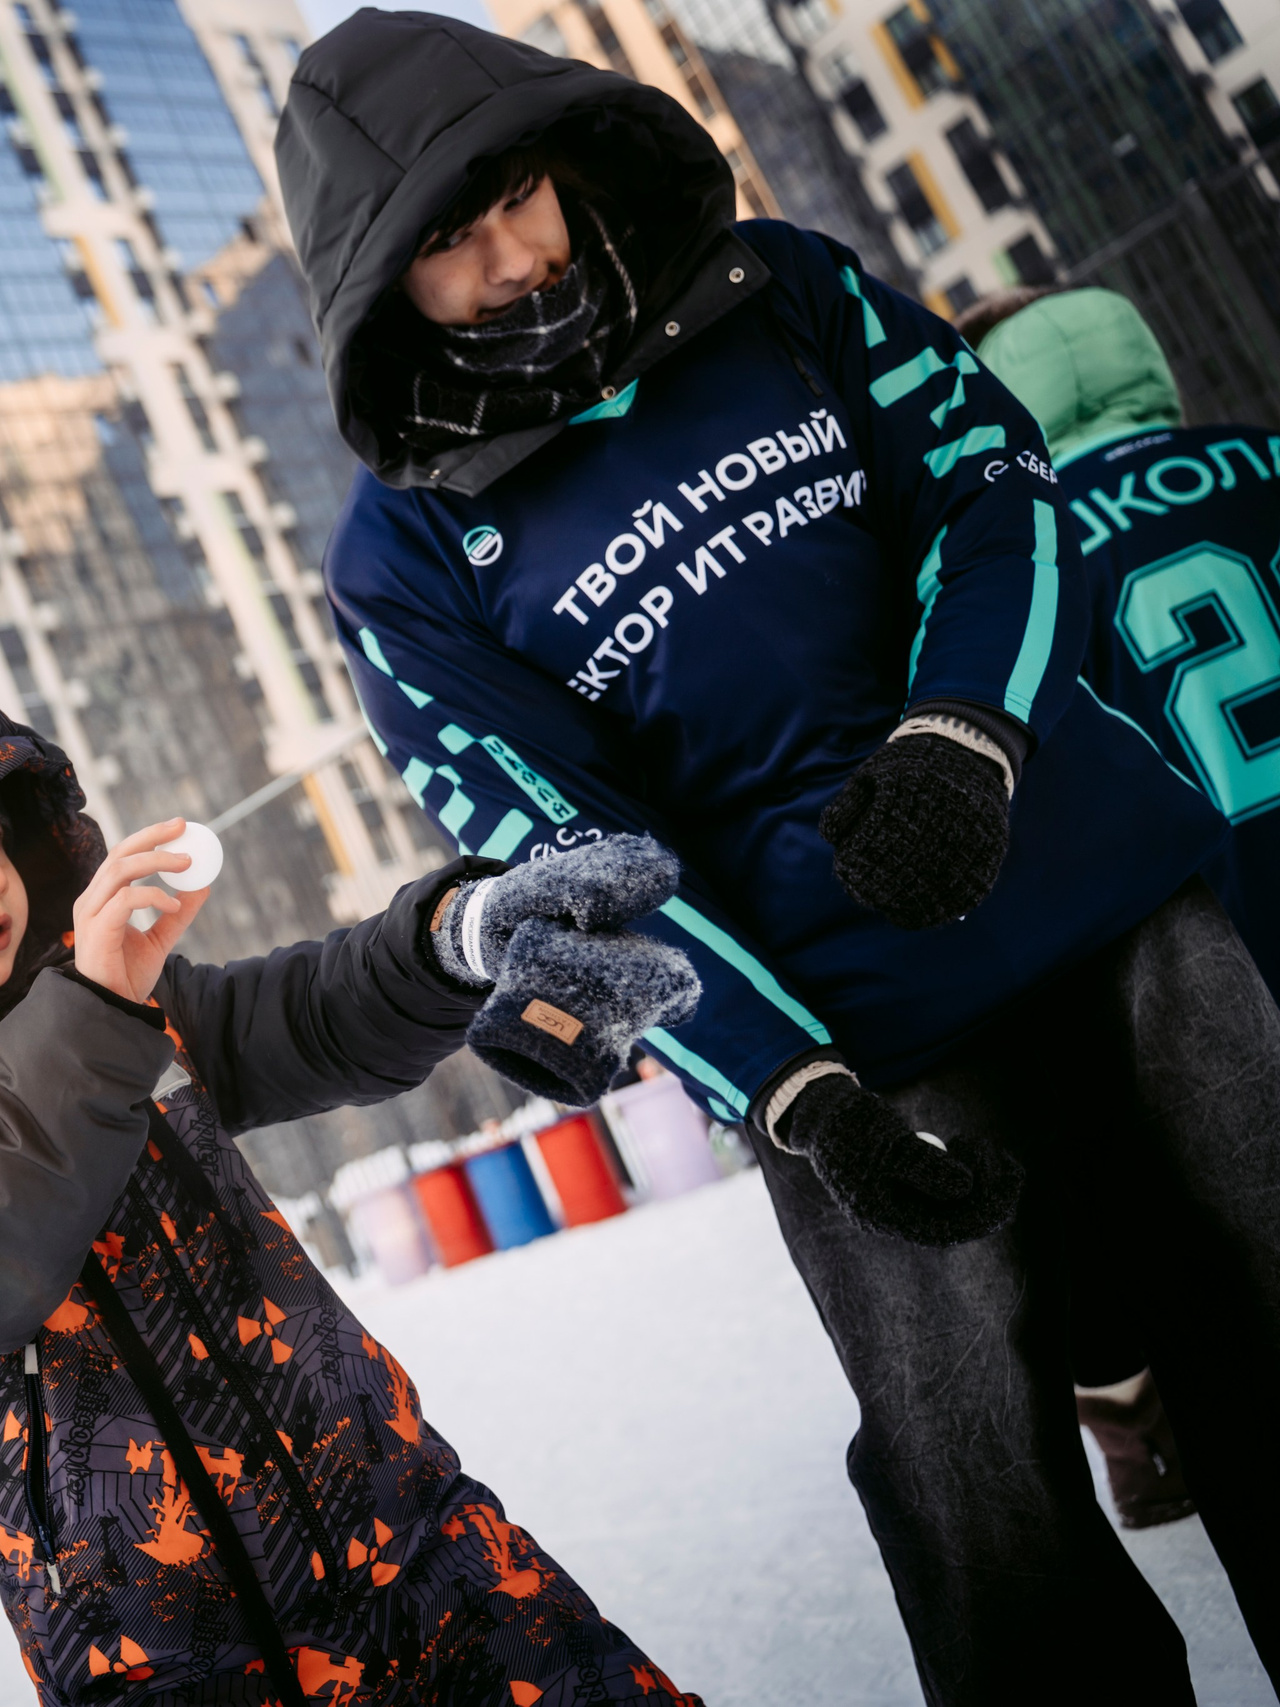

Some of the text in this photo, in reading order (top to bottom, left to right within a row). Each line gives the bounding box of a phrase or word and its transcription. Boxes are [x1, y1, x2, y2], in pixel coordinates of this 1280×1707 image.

[552, 408, 847, 626] ТВОЙ НОВЫЙ
[675, 525, 774, 596] ИТ
[741, 468, 868, 547] РАЗВИ
[1113, 541, 1280, 826] 2
